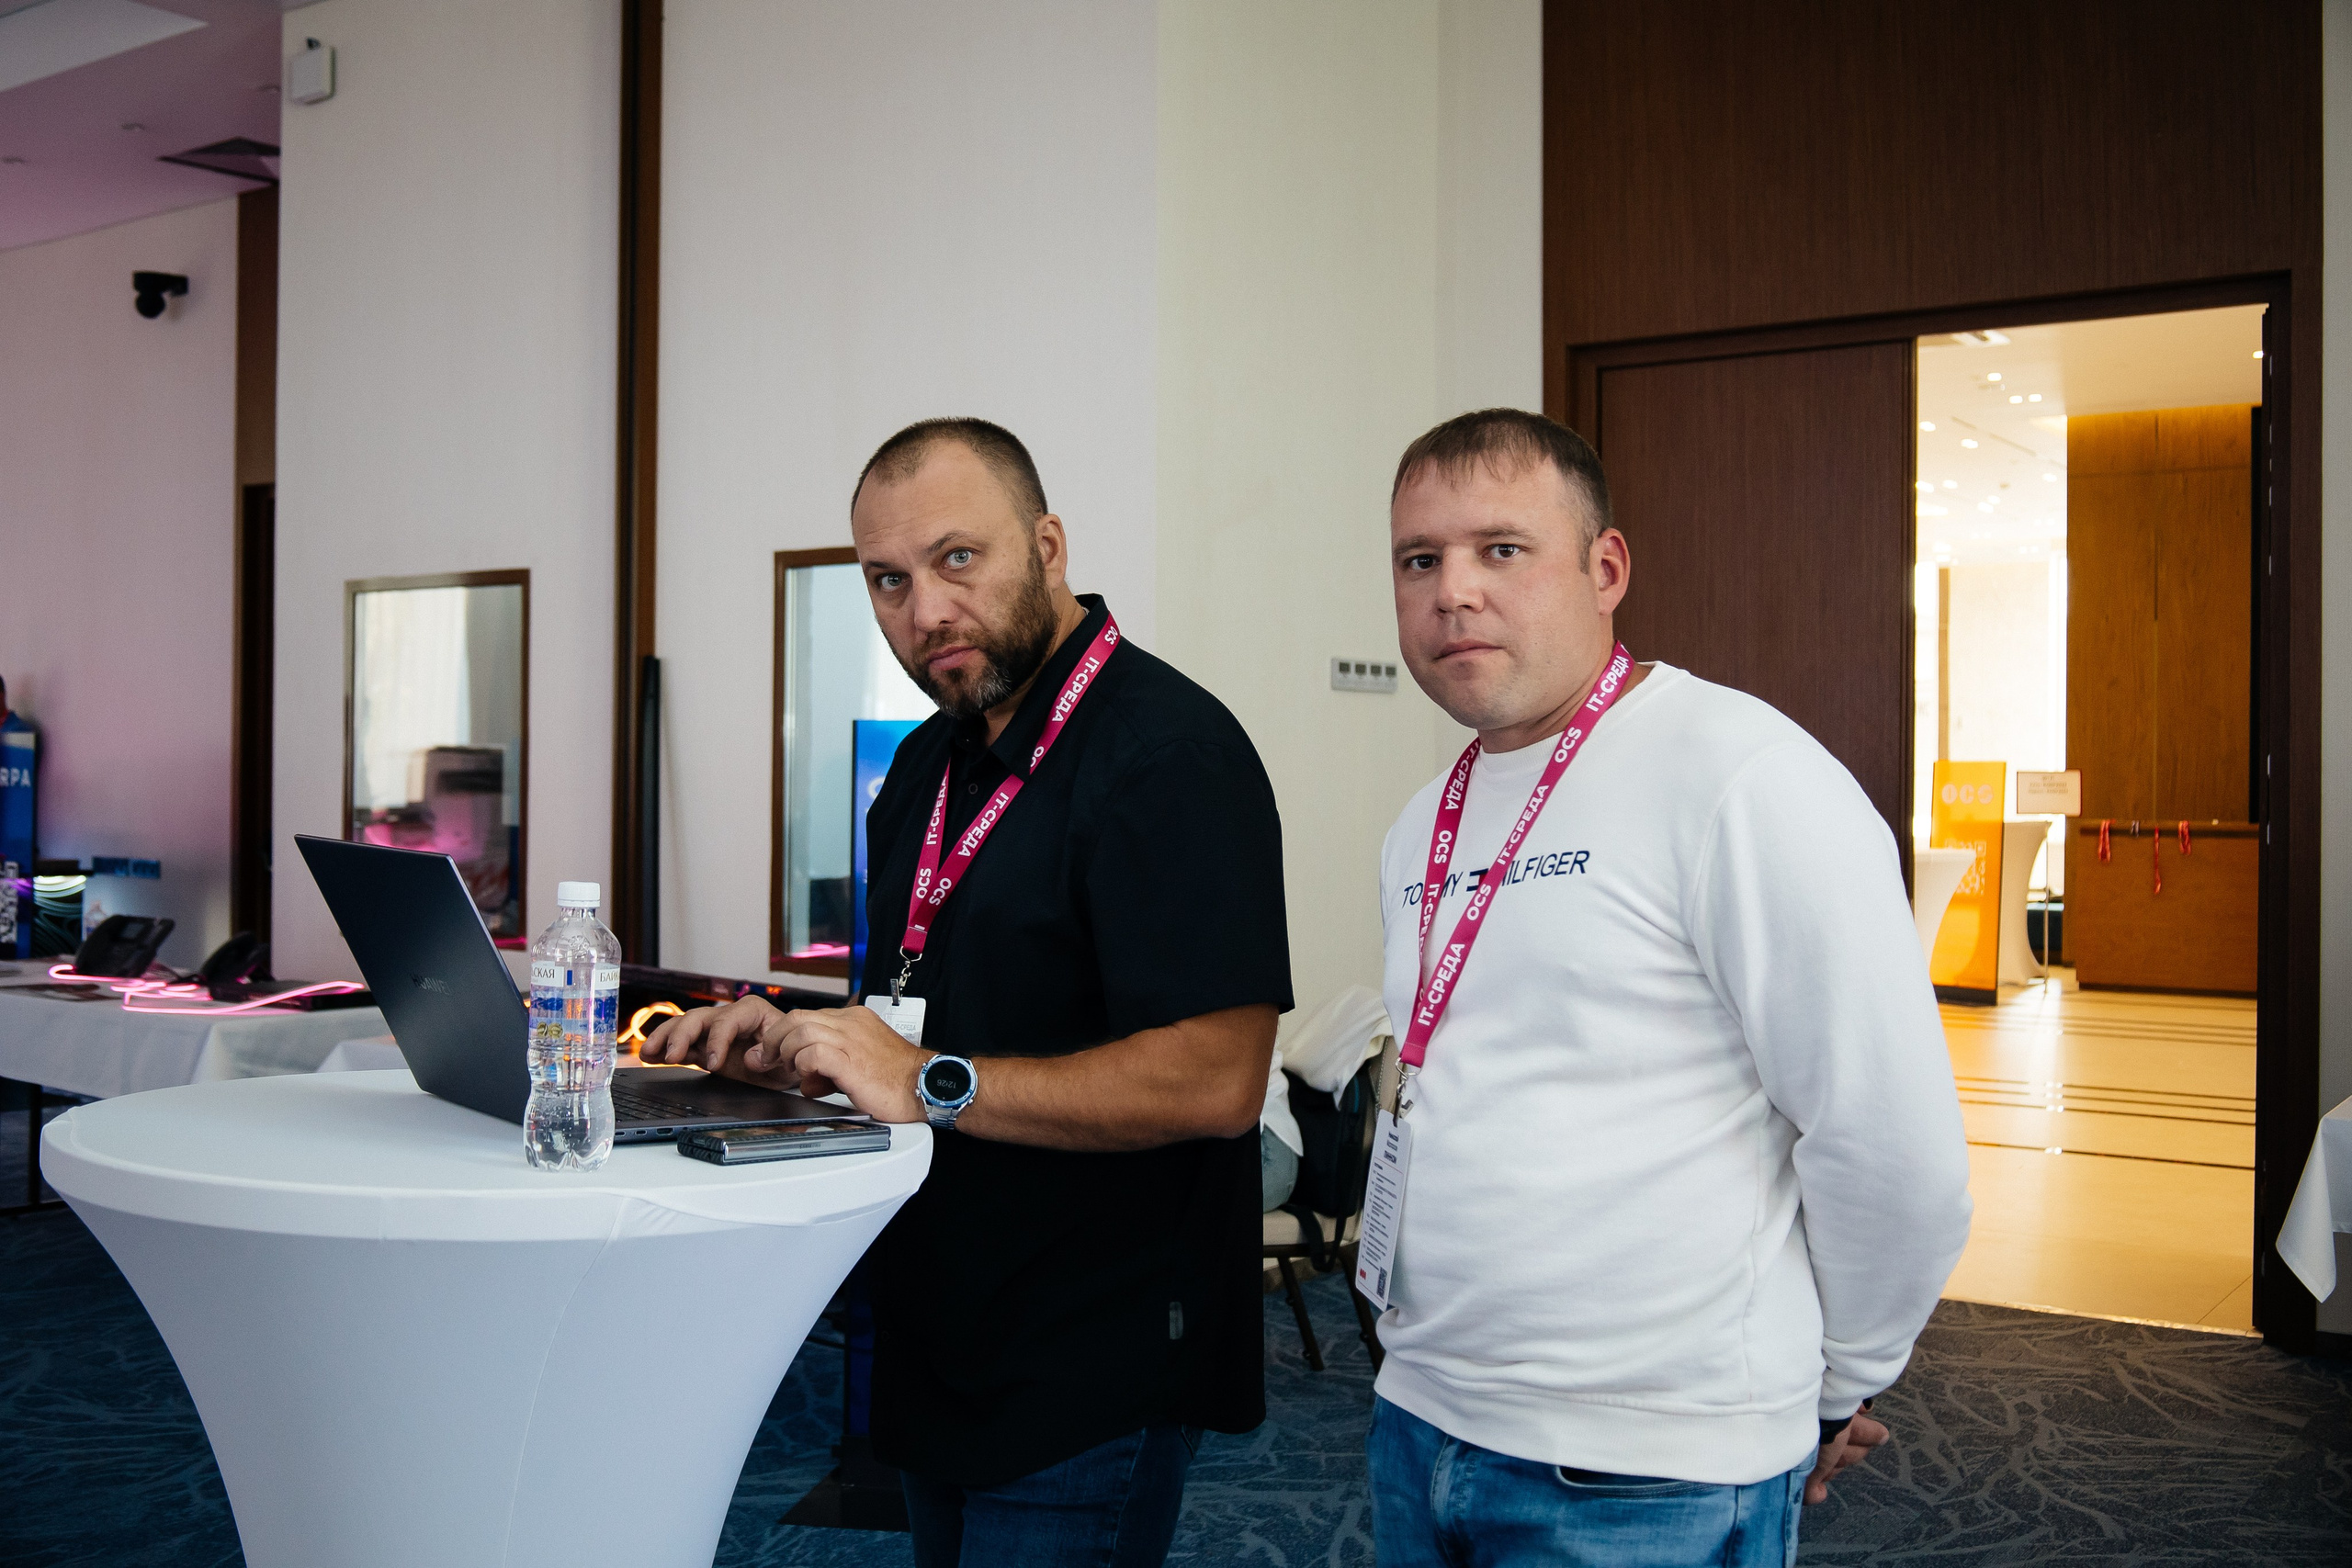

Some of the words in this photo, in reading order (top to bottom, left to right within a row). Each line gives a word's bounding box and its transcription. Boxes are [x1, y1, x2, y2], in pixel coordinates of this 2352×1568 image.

[1104, 626, 1118, 645] OCS
[1052, 656, 1100, 722] IT-СРЕДА
[1586, 655, 1629, 712] IT-СРЕДА
[1030, 746, 1045, 768] OC
[1555, 727, 1582, 763] OCS
[1445, 741, 1479, 810] IT-СРЕДА
[1941, 784, 1994, 805] OCS
[957, 792, 1010, 857] IT-СРЕДА
[1497, 784, 1549, 865] IT-СРЕДА
[1434, 829, 1453, 864] OCS
[915, 868, 932, 899] OCS
[929, 877, 952, 906] OCS
[1403, 872, 1464, 908] TOMY
[1466, 883, 1492, 920] OCS
[1418, 943, 1464, 1026] IT-СРЕДА
